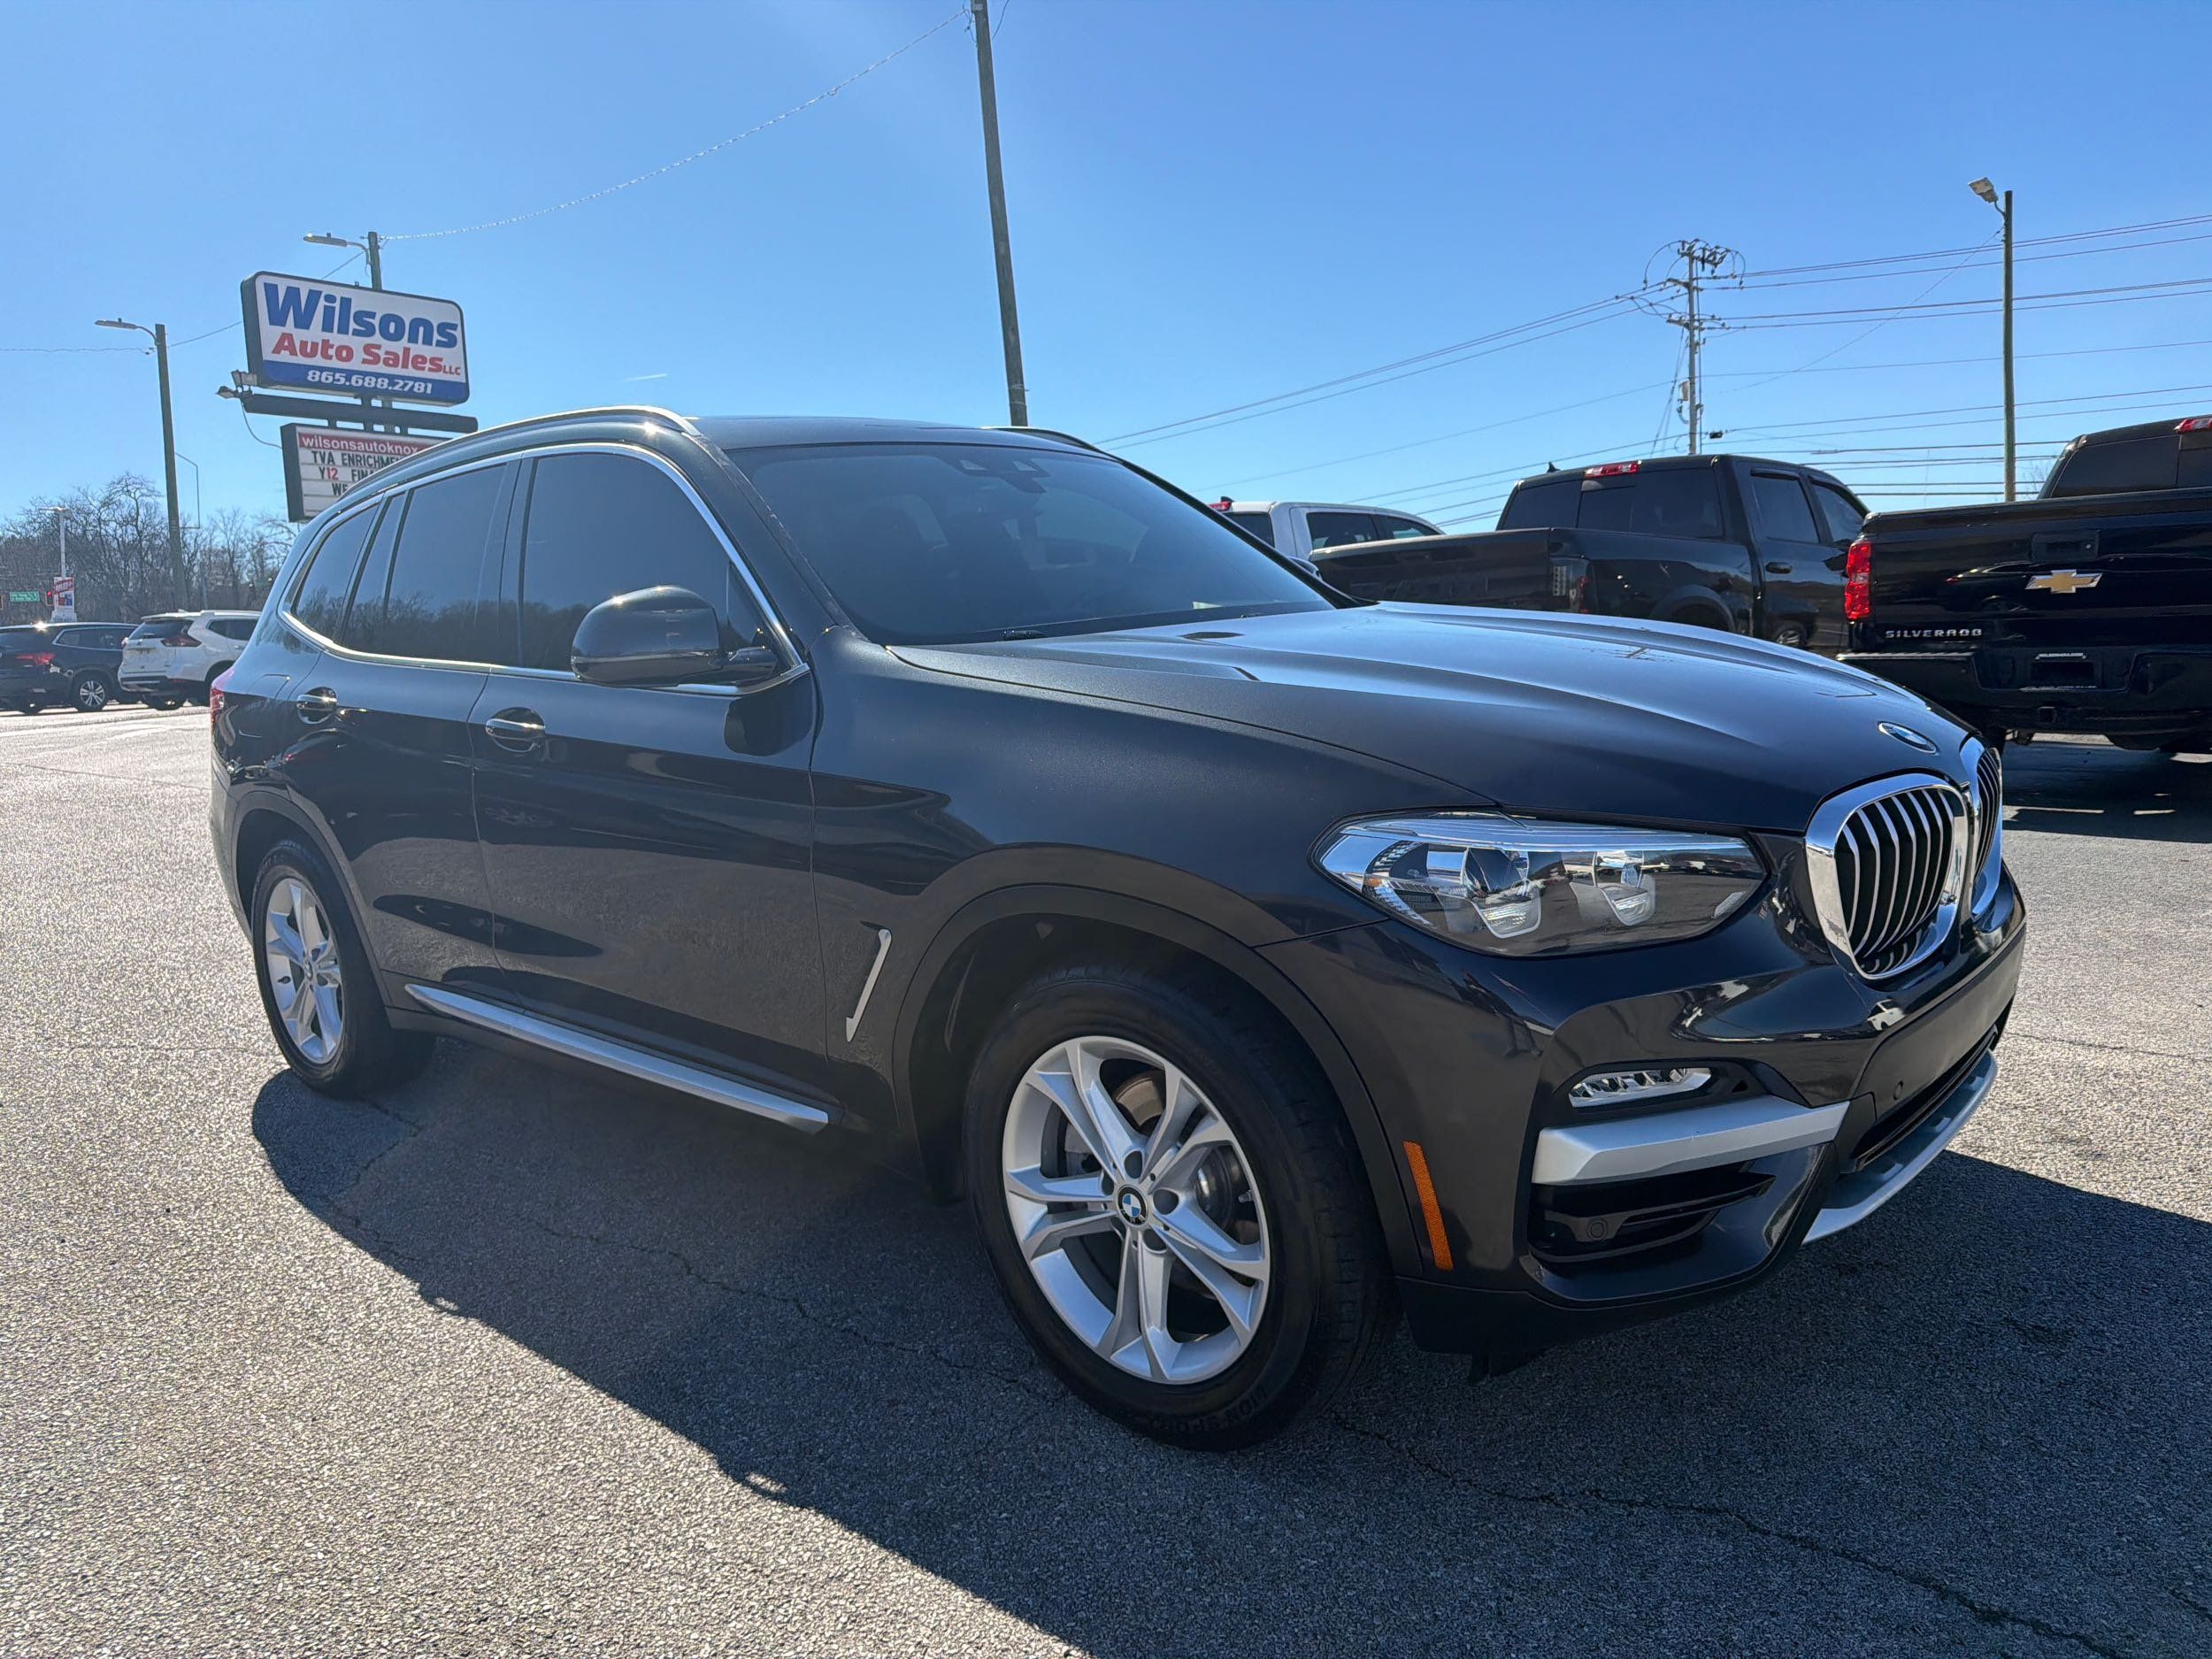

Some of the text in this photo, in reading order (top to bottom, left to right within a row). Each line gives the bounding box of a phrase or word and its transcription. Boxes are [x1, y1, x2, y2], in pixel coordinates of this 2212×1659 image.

[263, 281, 459, 349] Wilsons
[272, 332, 461, 376] Auto Sales LLC
[306, 370, 433, 395] 865.688.2781
[311, 450, 335, 465] TVA
[319, 466, 340, 480] Y12
[1885, 628, 1983, 639] SILVERADO
